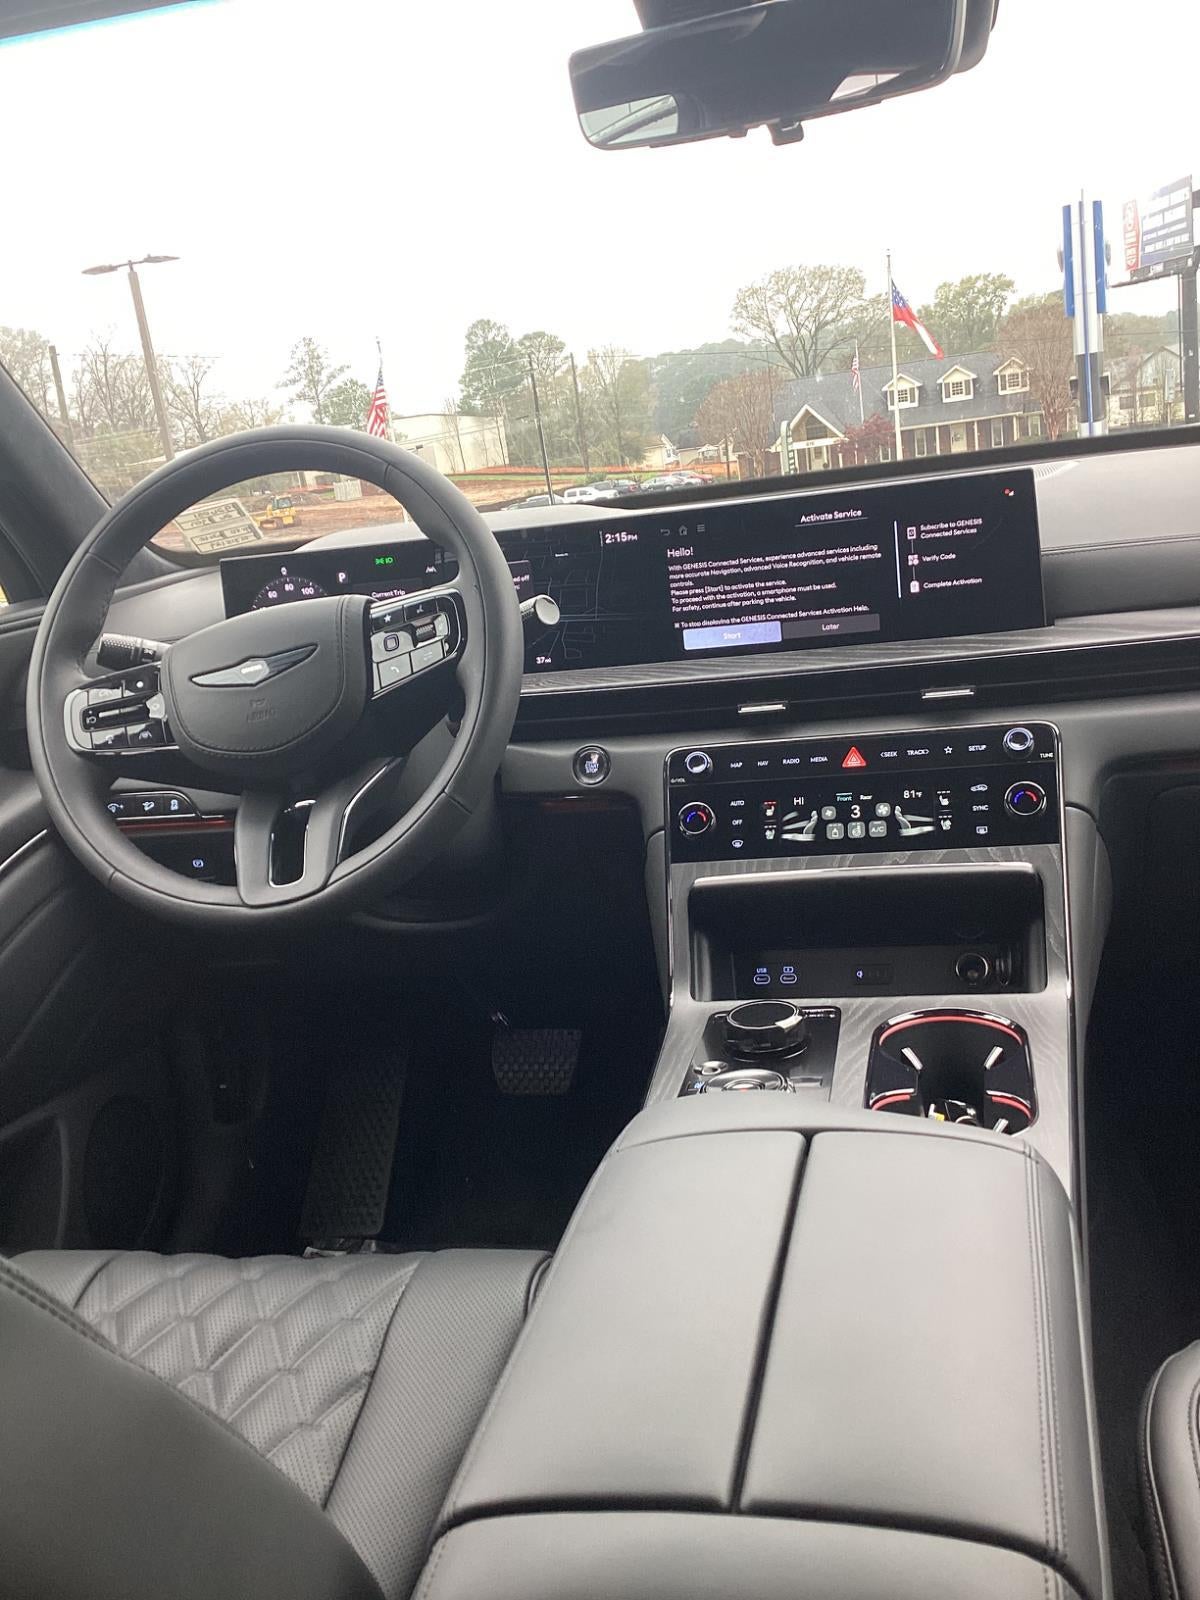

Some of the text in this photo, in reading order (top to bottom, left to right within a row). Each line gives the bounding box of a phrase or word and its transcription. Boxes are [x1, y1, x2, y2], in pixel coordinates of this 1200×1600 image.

[800, 509, 862, 523] Activate Service
[920, 522, 948, 531] Subscribe
[957, 518, 982, 526] GENESIS
[605, 532, 637, 544] 2:15PM
[921, 530, 952, 538] Connected
[667, 546, 694, 558] Hello!
[683, 562, 707, 570] GENESIS
[708, 559, 738, 568] Connected
[766, 553, 796, 561] experience
[797, 549, 825, 557] advanced
[850, 544, 878, 552] including
[940, 552, 956, 560] Code
[711, 567, 743, 576] Navigation,
[789, 559, 825, 568] Recognition,
[338, 572, 346, 583] P
[521, 574, 530, 582] off
[284, 583, 294, 591] 80
[670, 580, 694, 588] controls.
[705, 585, 724, 593] [Start]
[732, 582, 754, 590] activate
[923, 578, 982, 589] Complete Activation
[301, 587, 314, 595] 100
[371, 589, 406, 599] Current Trip
[680, 596, 702, 604] proceed
[762, 587, 796, 596] smartphone
[702, 601, 726, 609] continue
[742, 598, 764, 606] parking
[702, 617, 730, 625] displaying
[741, 614, 765, 622] GENESIS
[766, 611, 797, 619] Connected
[823, 606, 852, 614] Activation
[782, 757, 800, 765] RADIO
[793, 797, 804, 806] HI
[851, 804, 860, 818] 3
